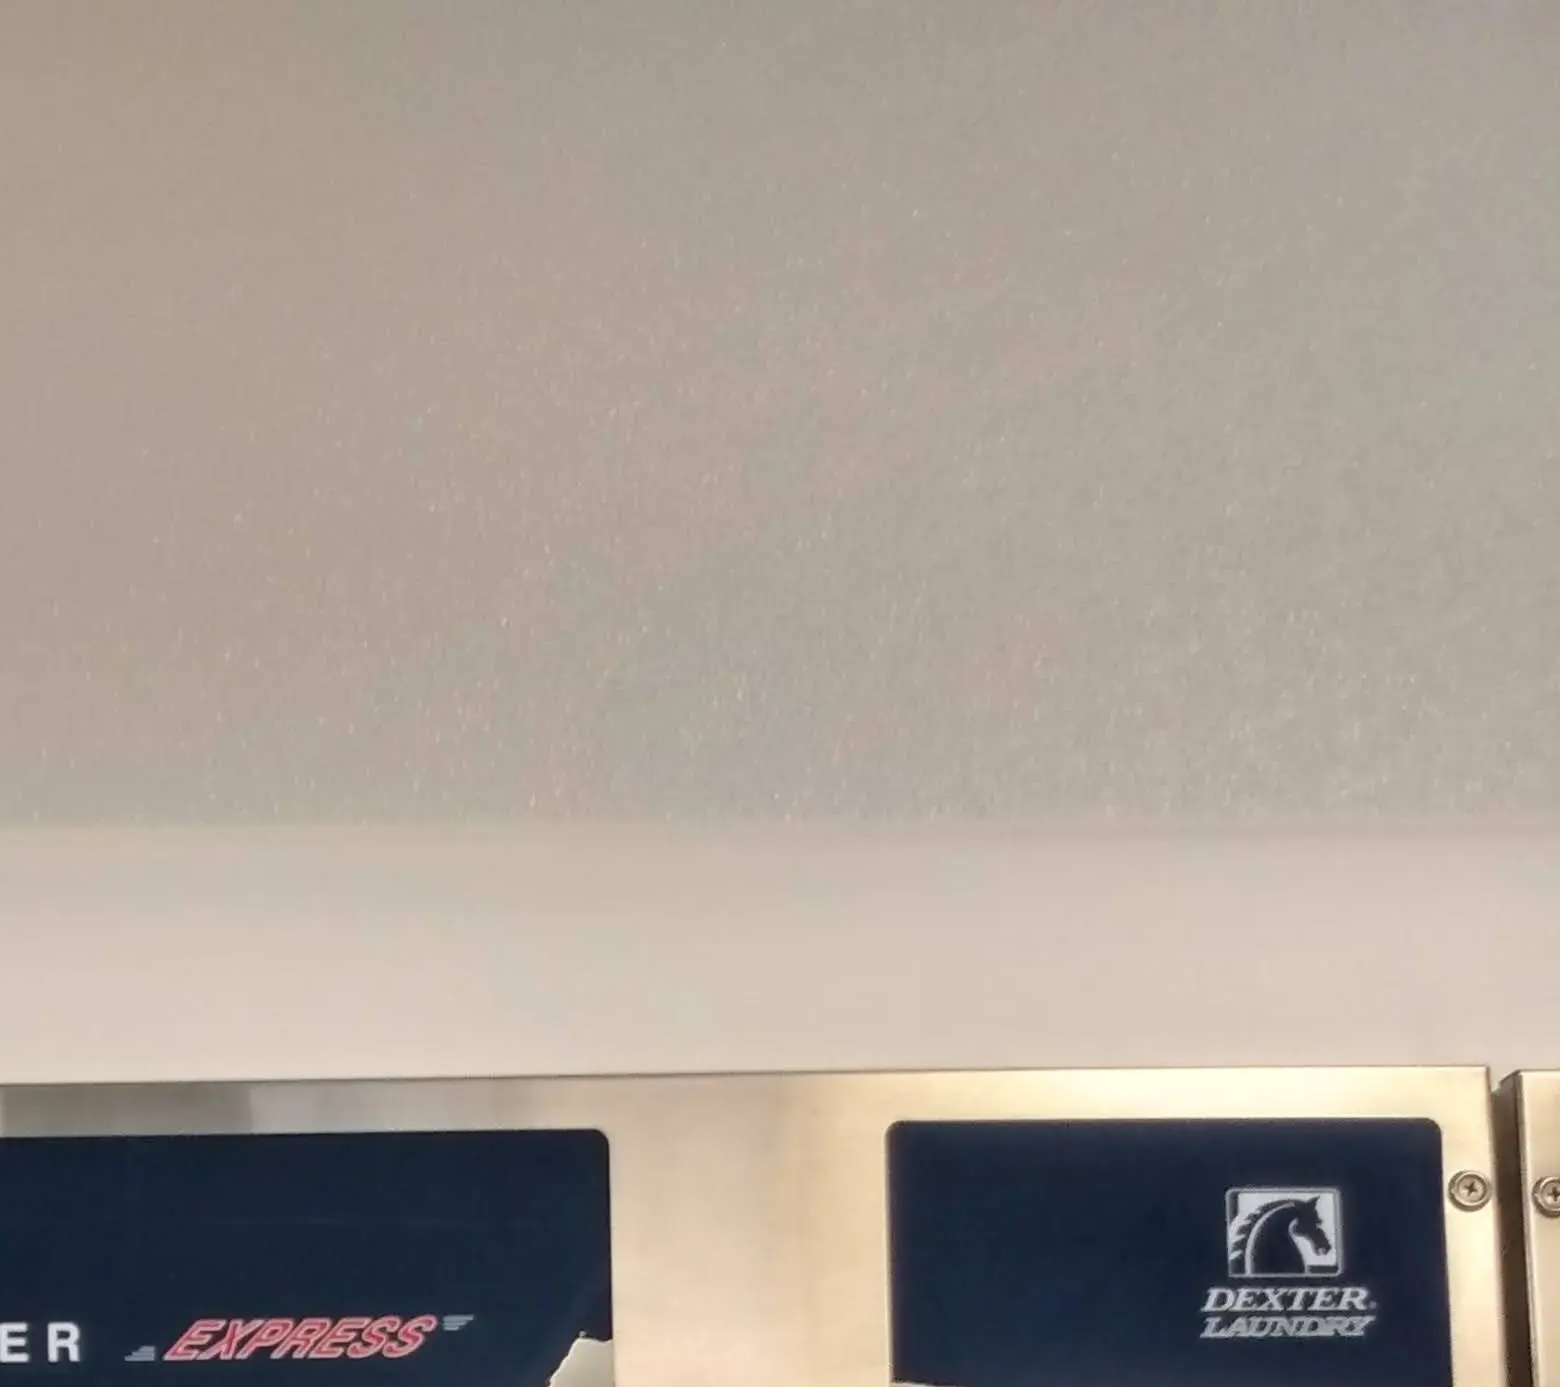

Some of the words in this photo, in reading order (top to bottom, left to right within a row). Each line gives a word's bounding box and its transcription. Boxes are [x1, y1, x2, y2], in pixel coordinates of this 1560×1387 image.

[1200, 1286, 1370, 1313] DEXTER
[162, 1315, 438, 1362] EXPRESS
[1199, 1315, 1376, 1339] LAUNDRY
